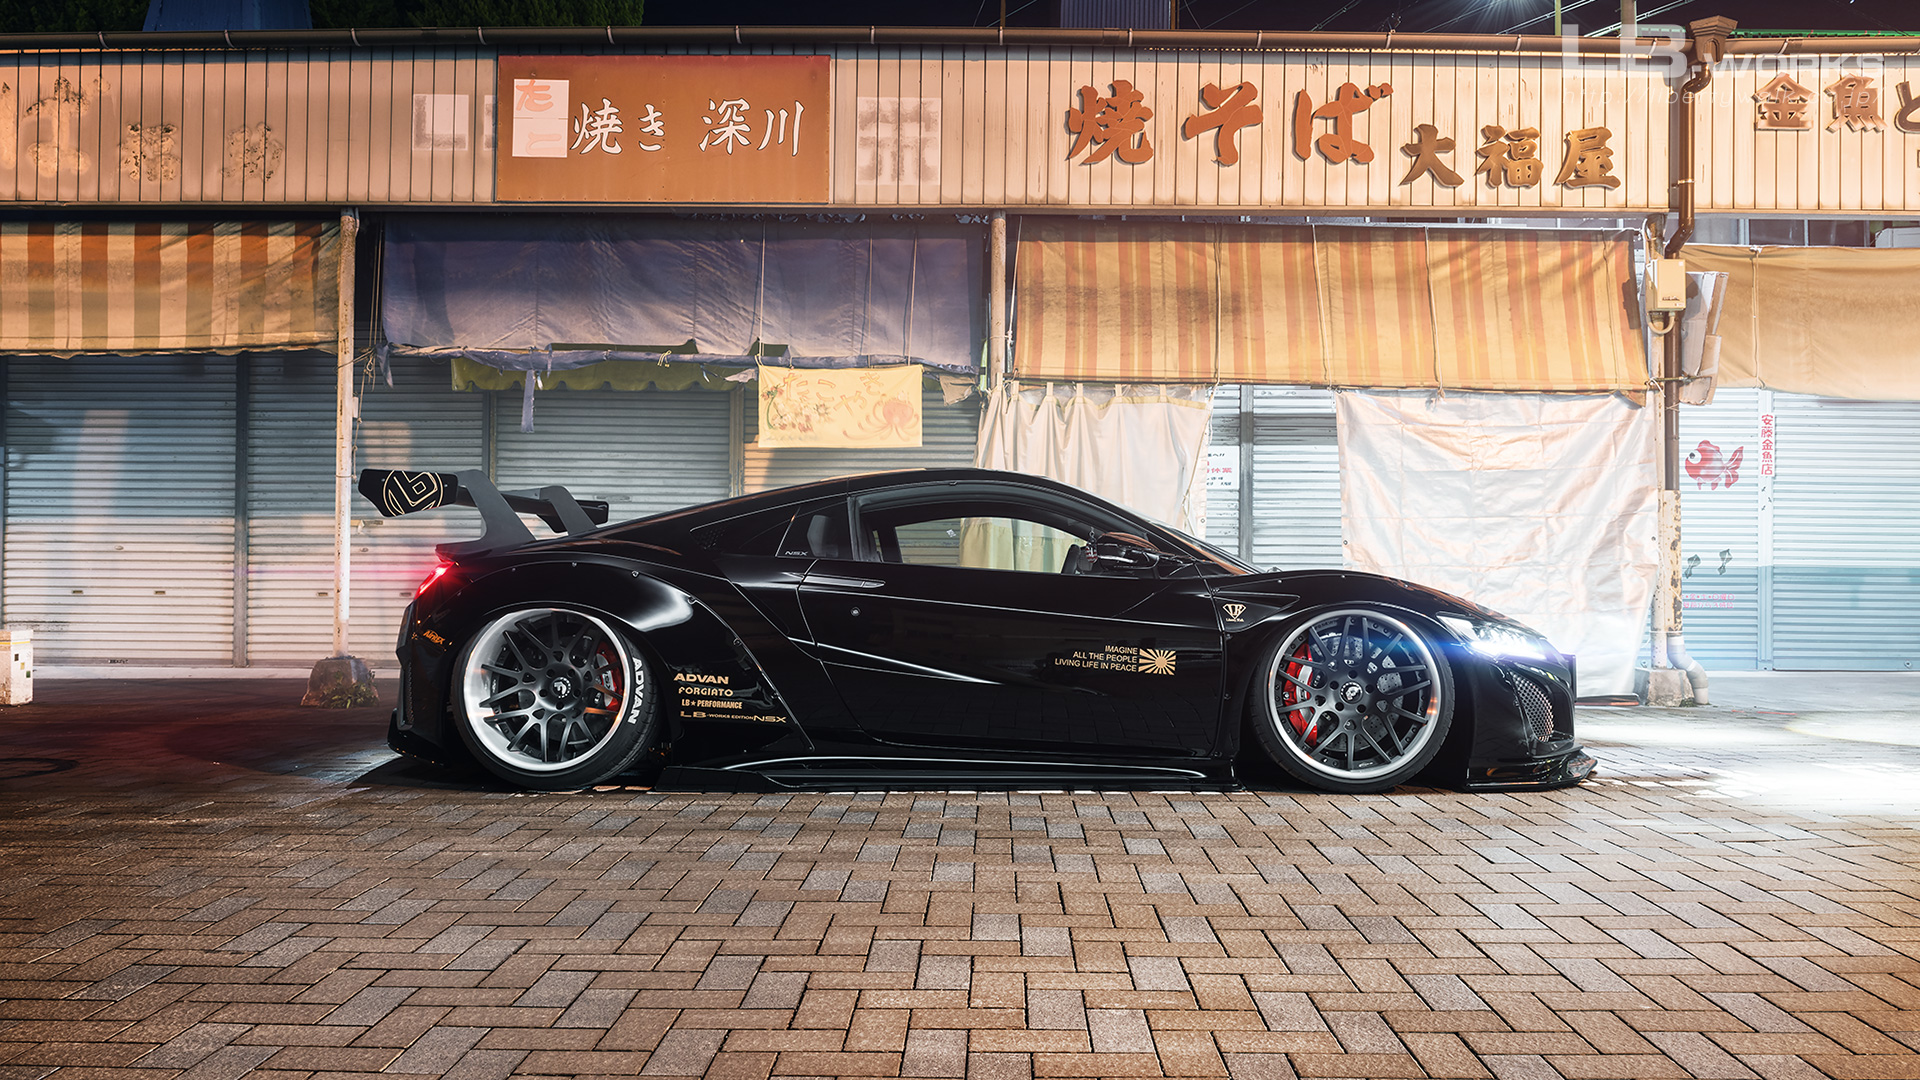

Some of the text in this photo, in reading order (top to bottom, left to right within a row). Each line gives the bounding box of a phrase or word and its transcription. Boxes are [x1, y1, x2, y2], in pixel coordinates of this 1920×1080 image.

[698, 97, 805, 157] 深川
[1064, 79, 1622, 190] 焼そば 大福屋
[783, 372, 884, 416] たこやき
[1761, 414, 1774, 476] 安藤金魚店
[1072, 651, 1138, 664] ALL THE PEOPLE
[1104, 645, 1139, 655] IMAGINE
[673, 673, 729, 685] ADVAN
[1054, 658, 1137, 673] LIVING LIFE IN PEACE
[627, 657, 645, 725] ADVAN
[678, 686, 734, 697] FORGIATO
